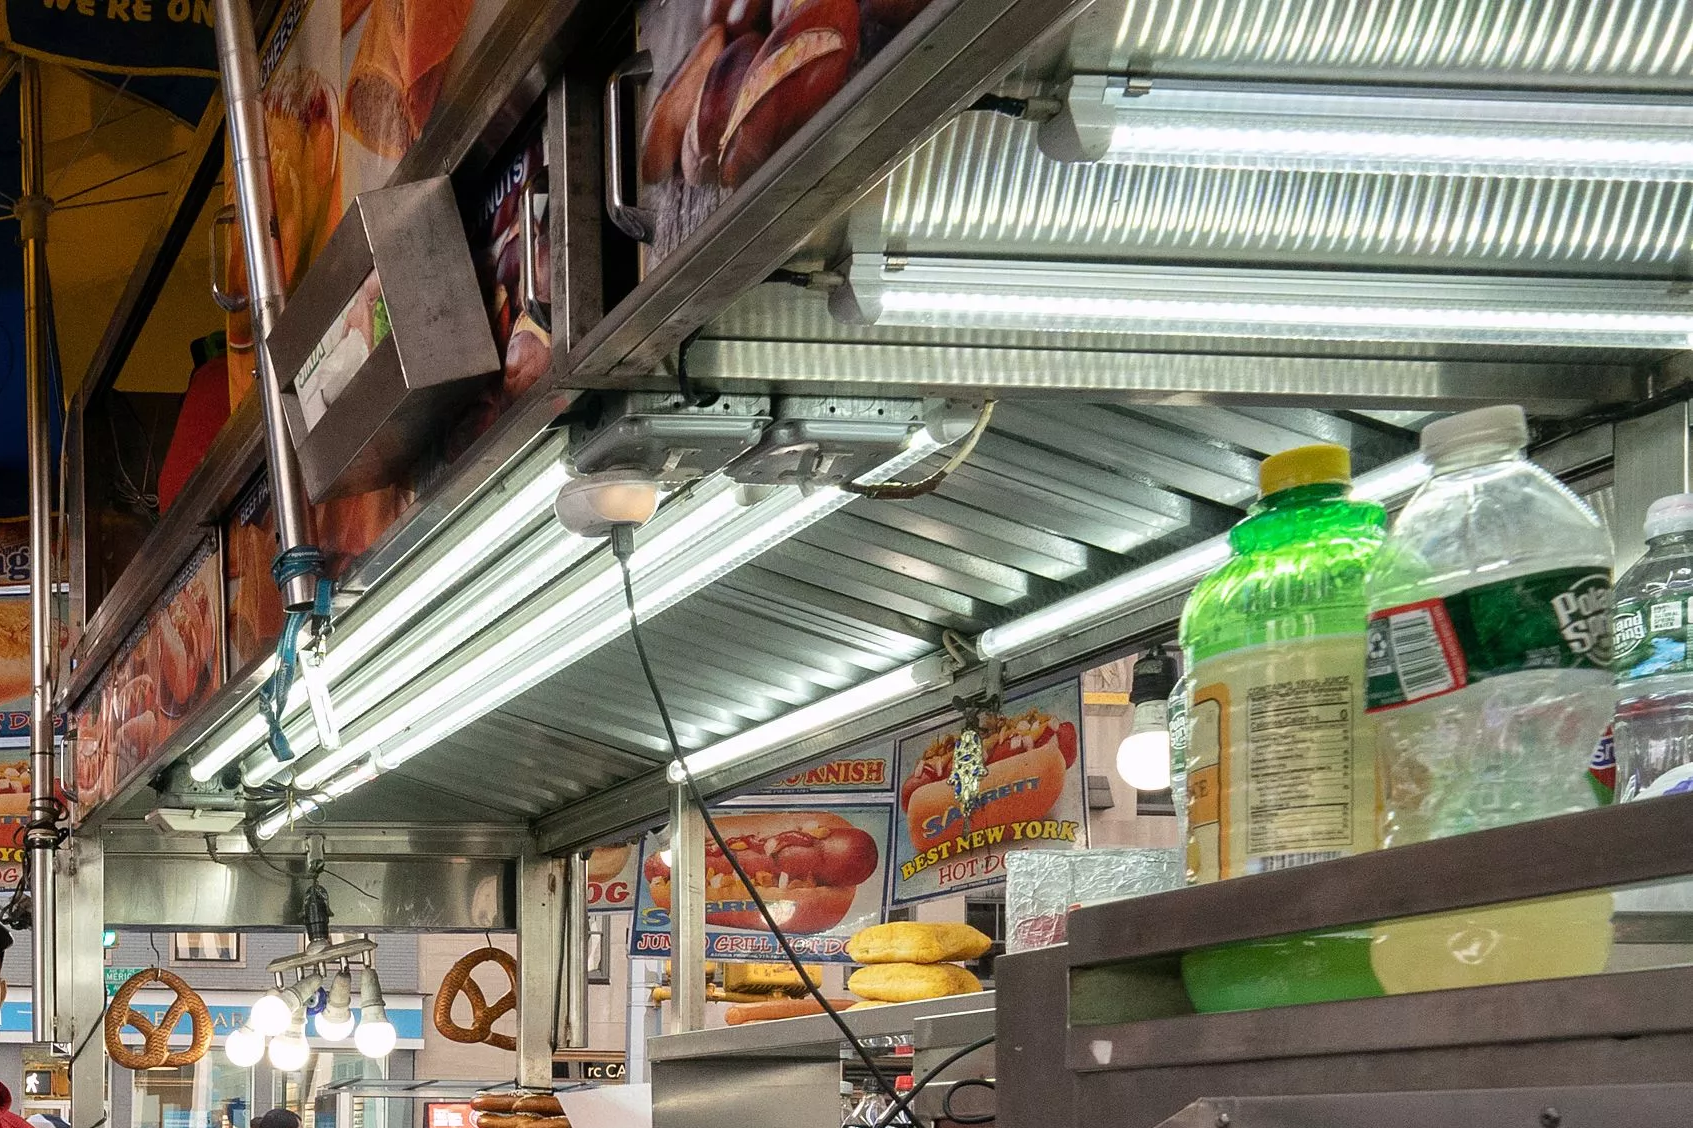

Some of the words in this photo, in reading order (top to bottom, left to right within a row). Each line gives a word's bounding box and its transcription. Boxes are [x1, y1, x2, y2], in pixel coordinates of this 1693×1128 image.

[804, 759, 886, 785] KNISH
[900, 840, 953, 882] BEST
[956, 824, 1008, 853] NEW
[1009, 819, 1080, 842] YORK
[938, 859, 979, 886] HOT
[714, 935, 773, 953] GRILL
